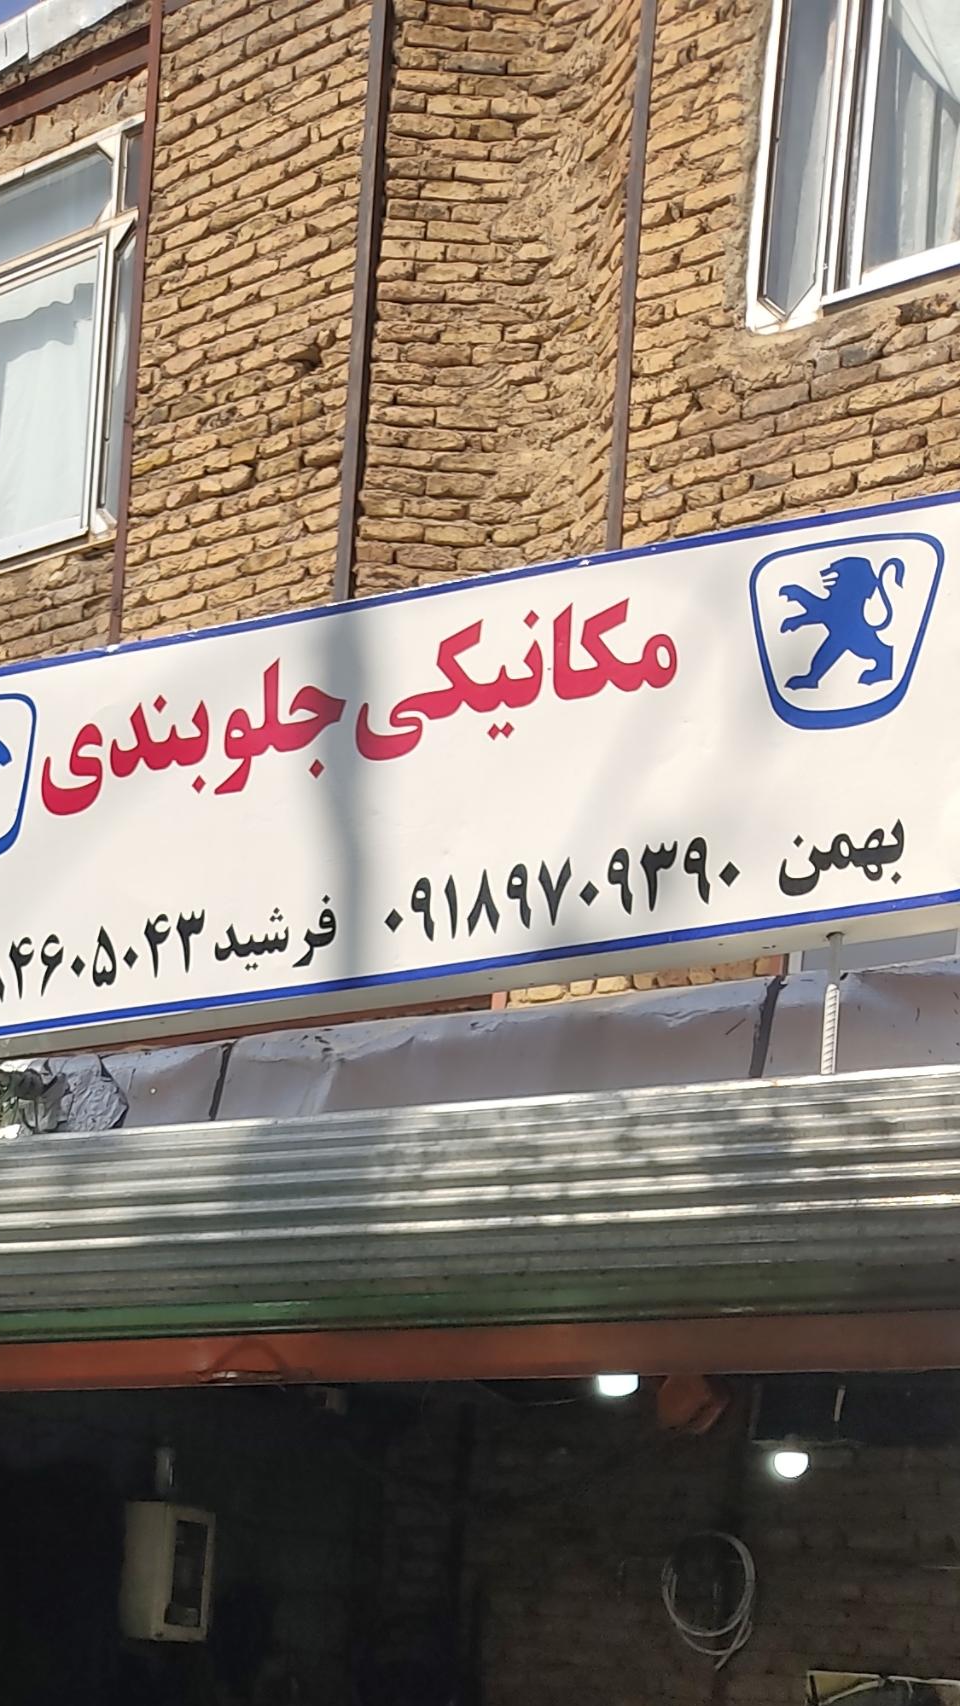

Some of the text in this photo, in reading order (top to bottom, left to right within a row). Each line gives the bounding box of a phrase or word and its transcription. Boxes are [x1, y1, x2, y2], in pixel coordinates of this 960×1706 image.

[355, 598, 679, 761] مکانیکی
[384, 836, 740, 942] ۰۹۱۸۹۷۰۹۳۹۰
[778, 818, 906, 897] بهمن
[214, 895, 338, 971] فرشید
